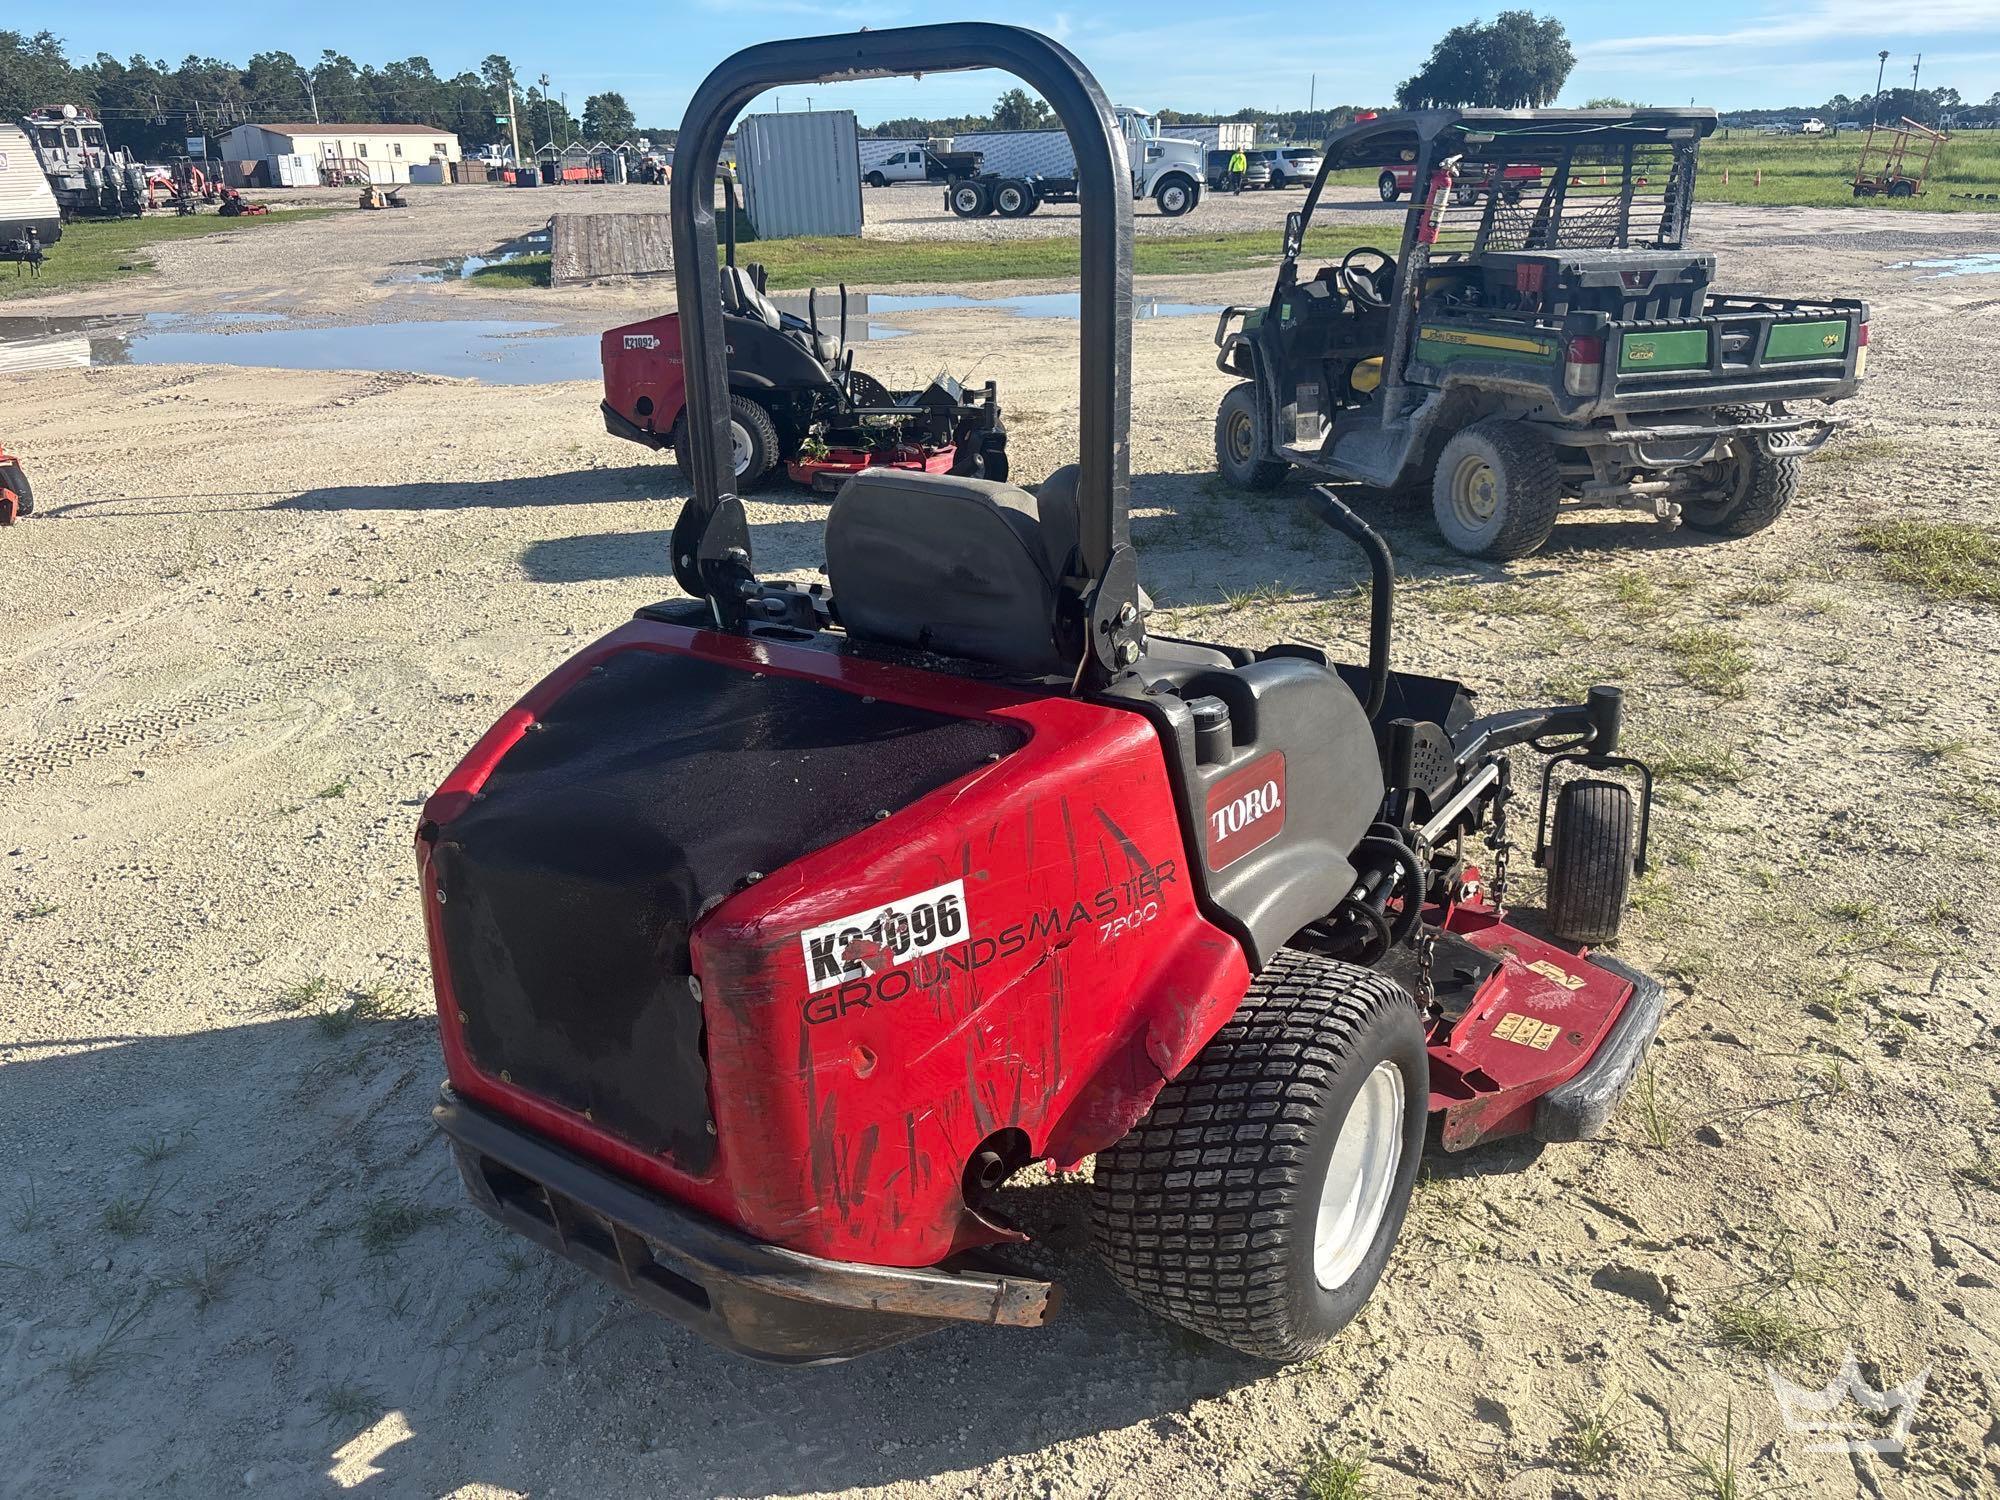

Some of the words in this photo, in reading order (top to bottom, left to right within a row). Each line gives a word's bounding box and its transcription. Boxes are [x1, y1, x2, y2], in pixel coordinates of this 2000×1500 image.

[1629, 351, 1654, 360] GATOR
[803, 859, 1176, 1025] GROUNDSMASTER
[1101, 901, 1158, 944] 7200
